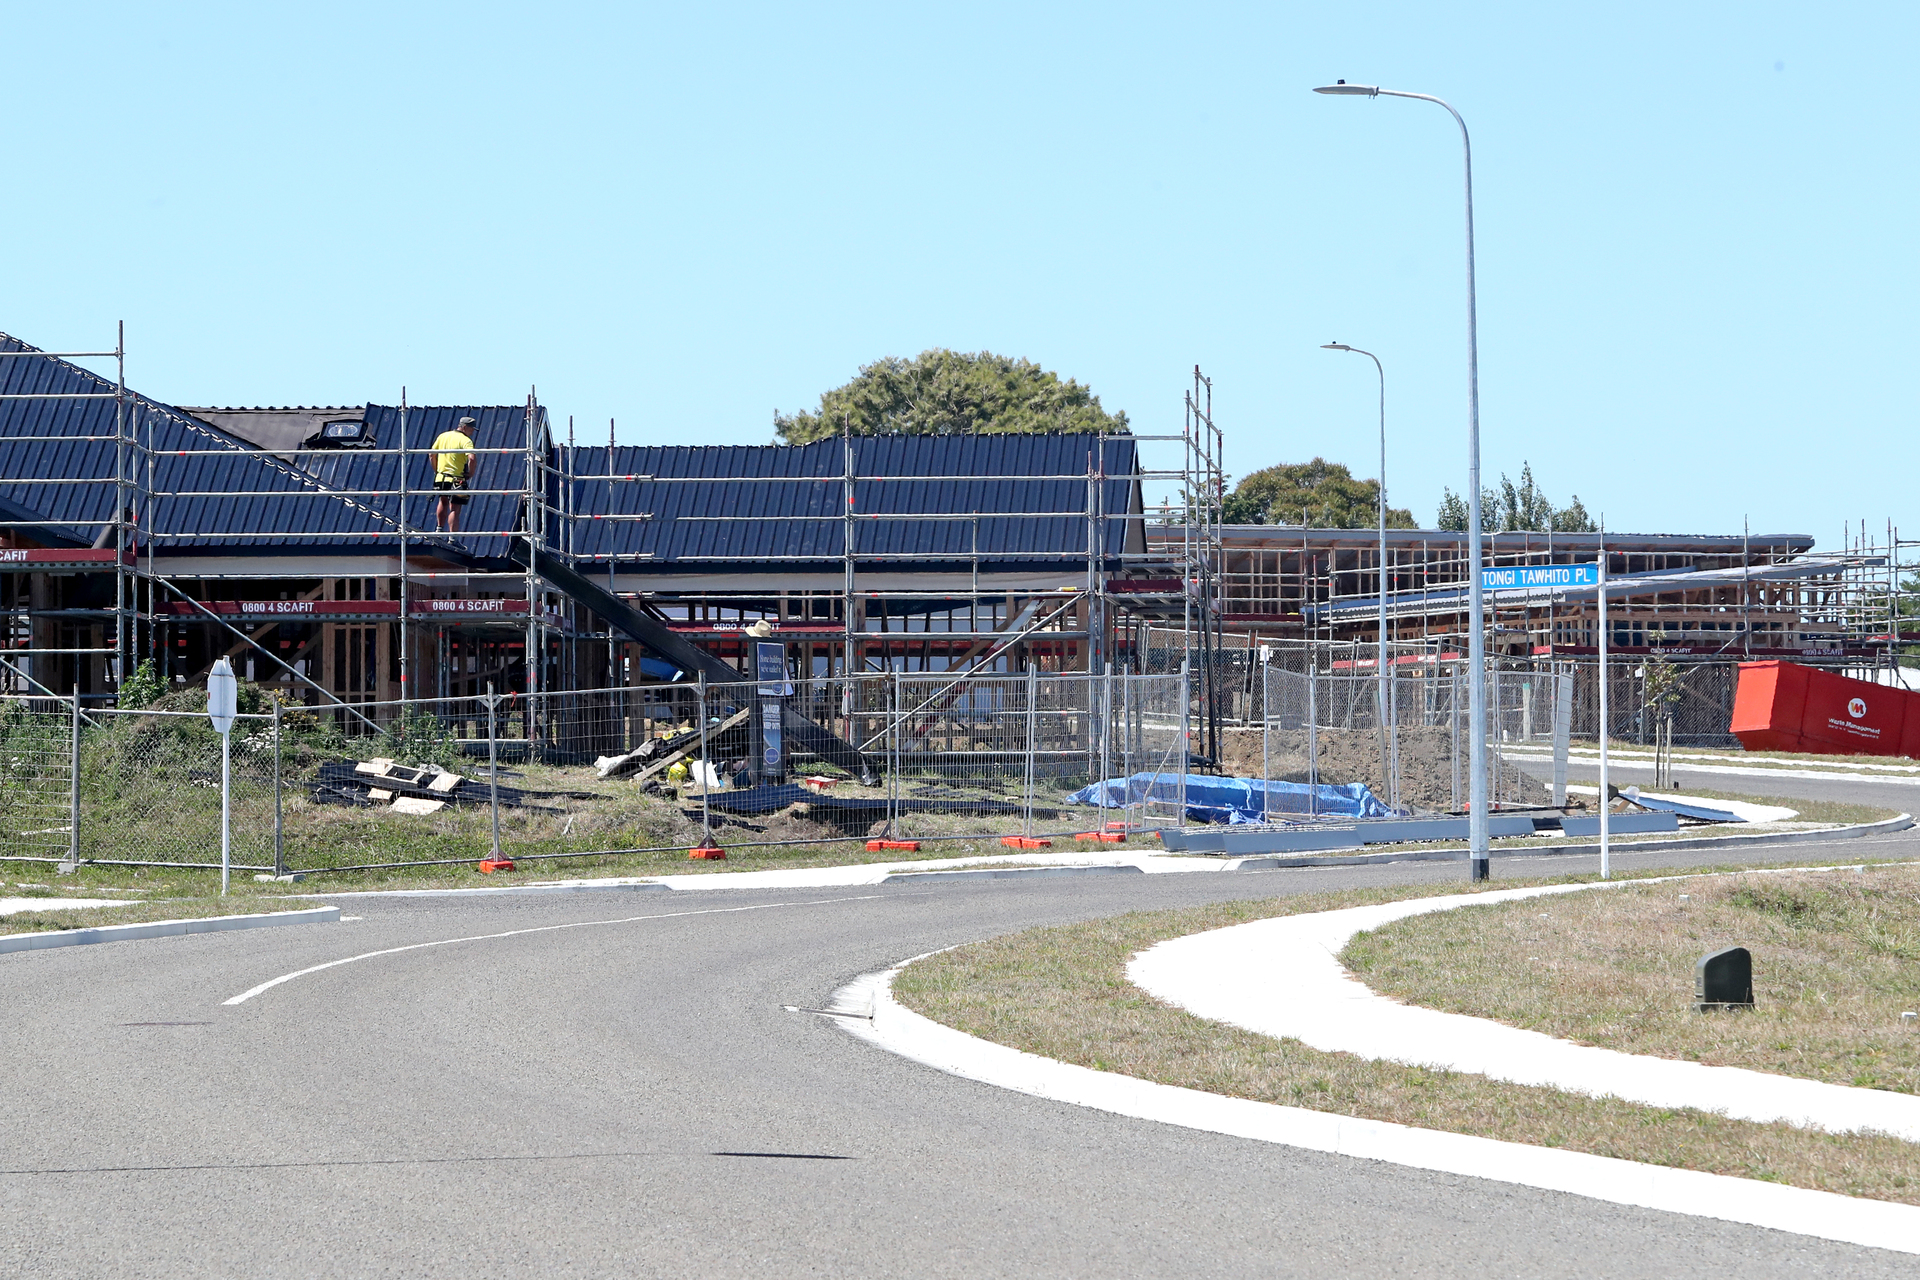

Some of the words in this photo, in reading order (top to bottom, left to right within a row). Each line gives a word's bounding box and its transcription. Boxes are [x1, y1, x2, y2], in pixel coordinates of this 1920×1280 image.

[1520, 568, 1570, 584] TAWHITO
[1575, 567, 1591, 582] PL
[242, 602, 266, 613] 0800
[267, 602, 275, 613] 4
[276, 602, 315, 612] SCAFIT
[432, 601, 456, 611] 0800
[458, 601, 465, 611] 4
[467, 600, 505, 611] SCAFIT
[713, 623, 737, 631] 0800
